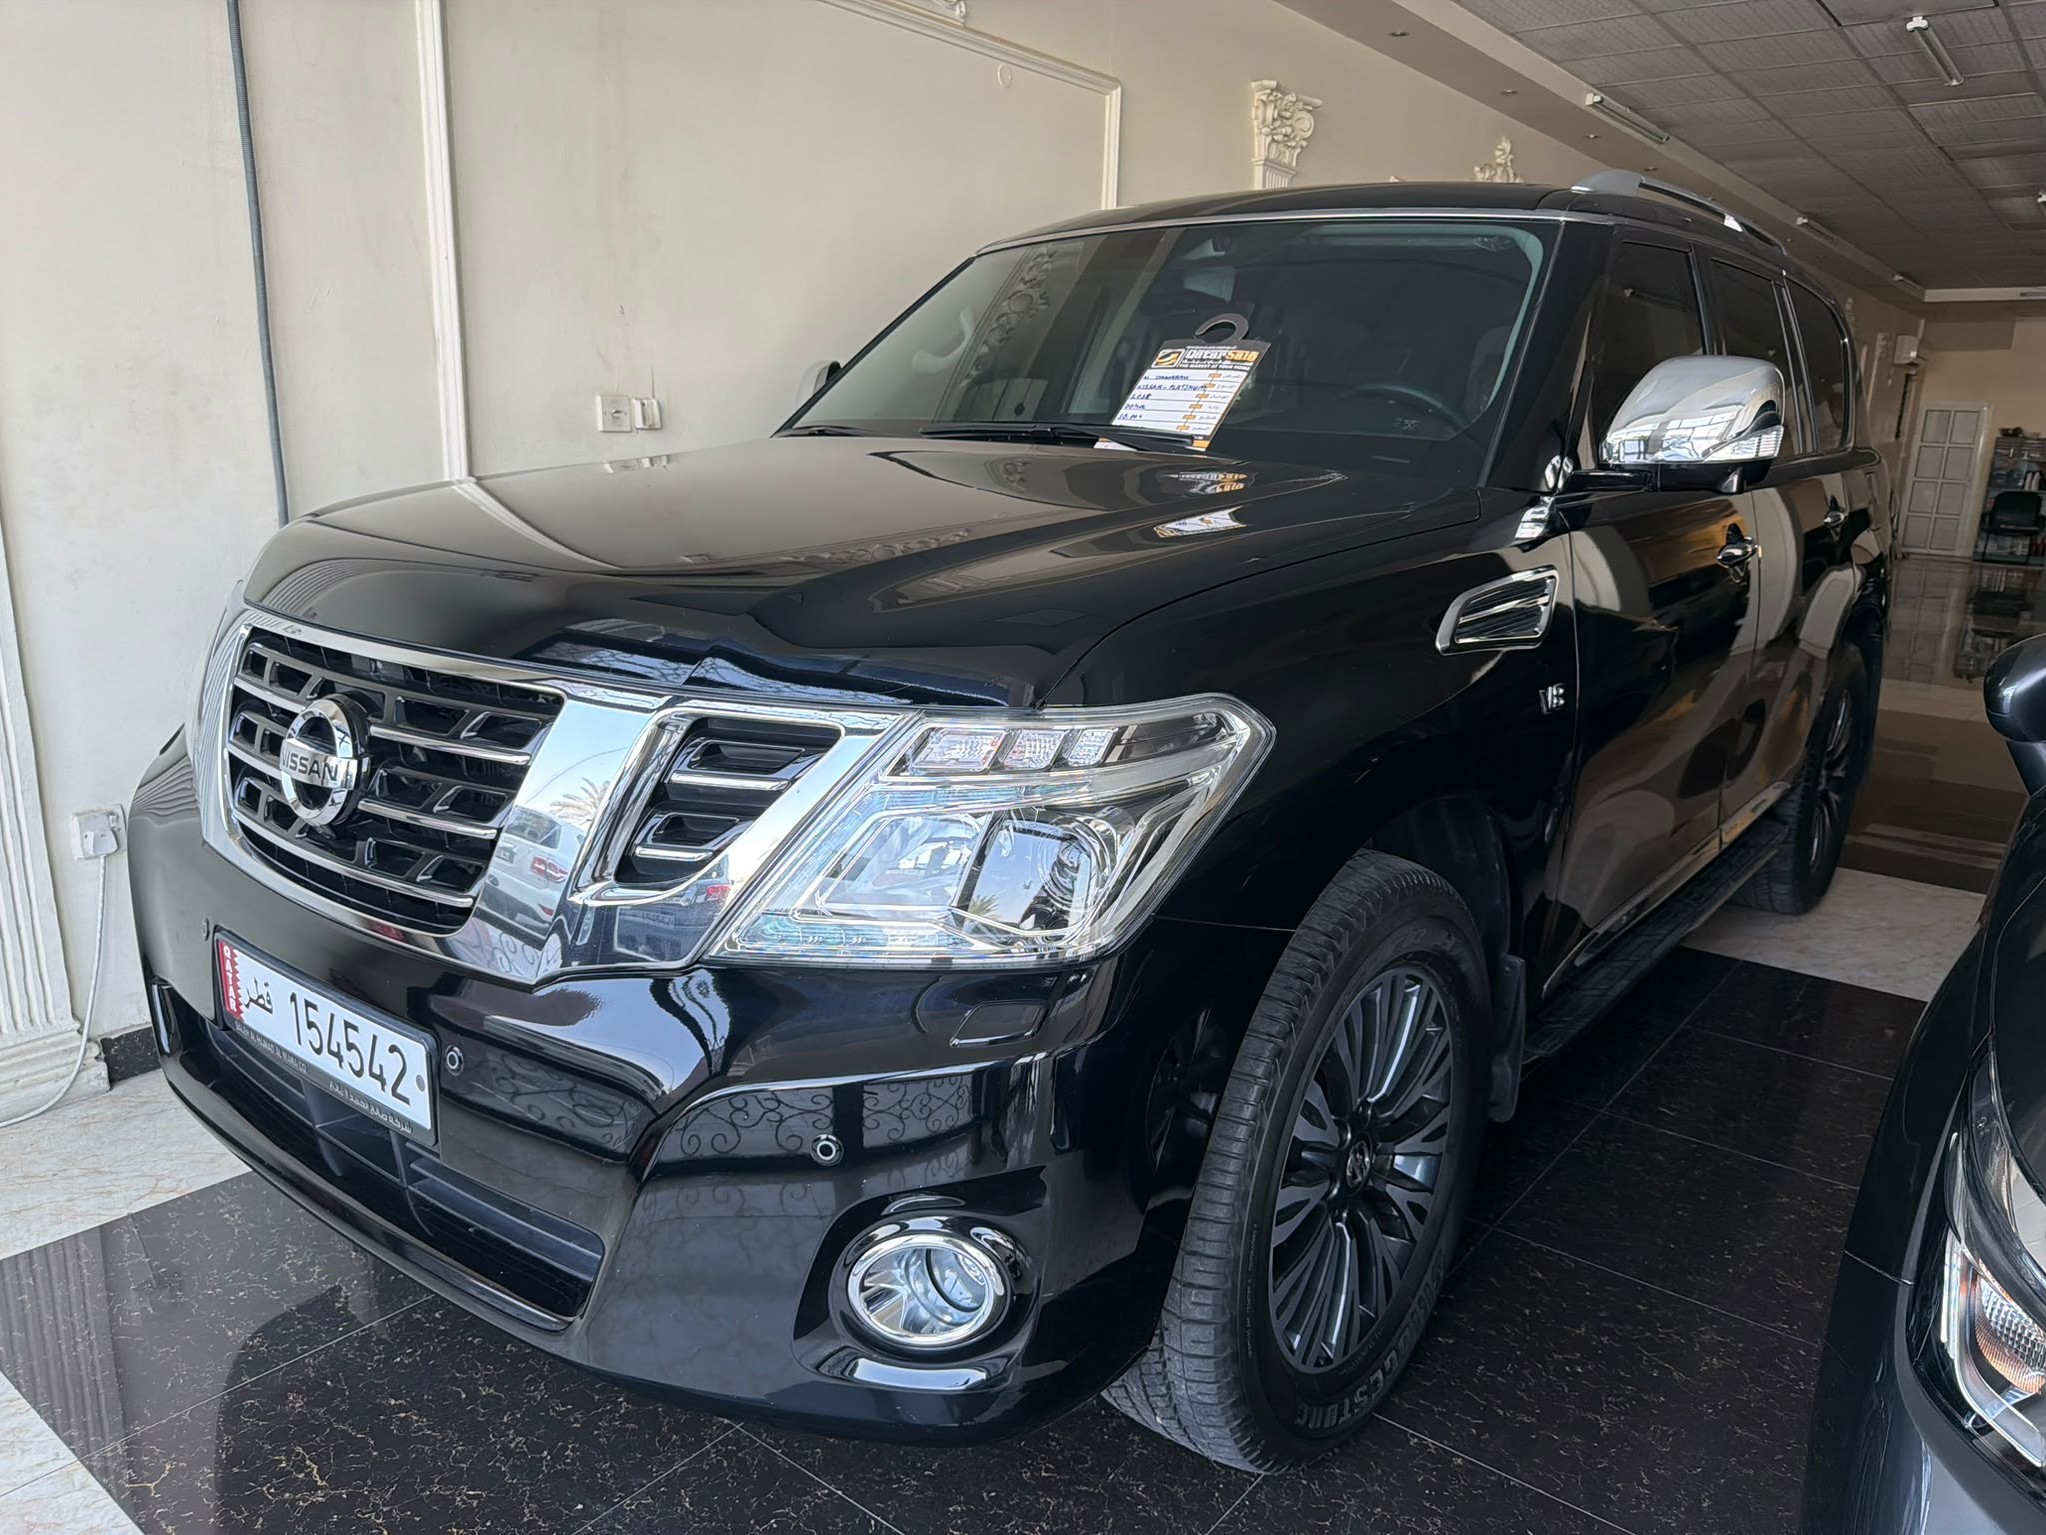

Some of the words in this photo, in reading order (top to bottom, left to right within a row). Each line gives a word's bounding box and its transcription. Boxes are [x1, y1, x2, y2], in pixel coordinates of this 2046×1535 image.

[222, 944, 238, 1013] QATAR
[244, 975, 274, 1015] قطر
[290, 991, 411, 1107] 154542
